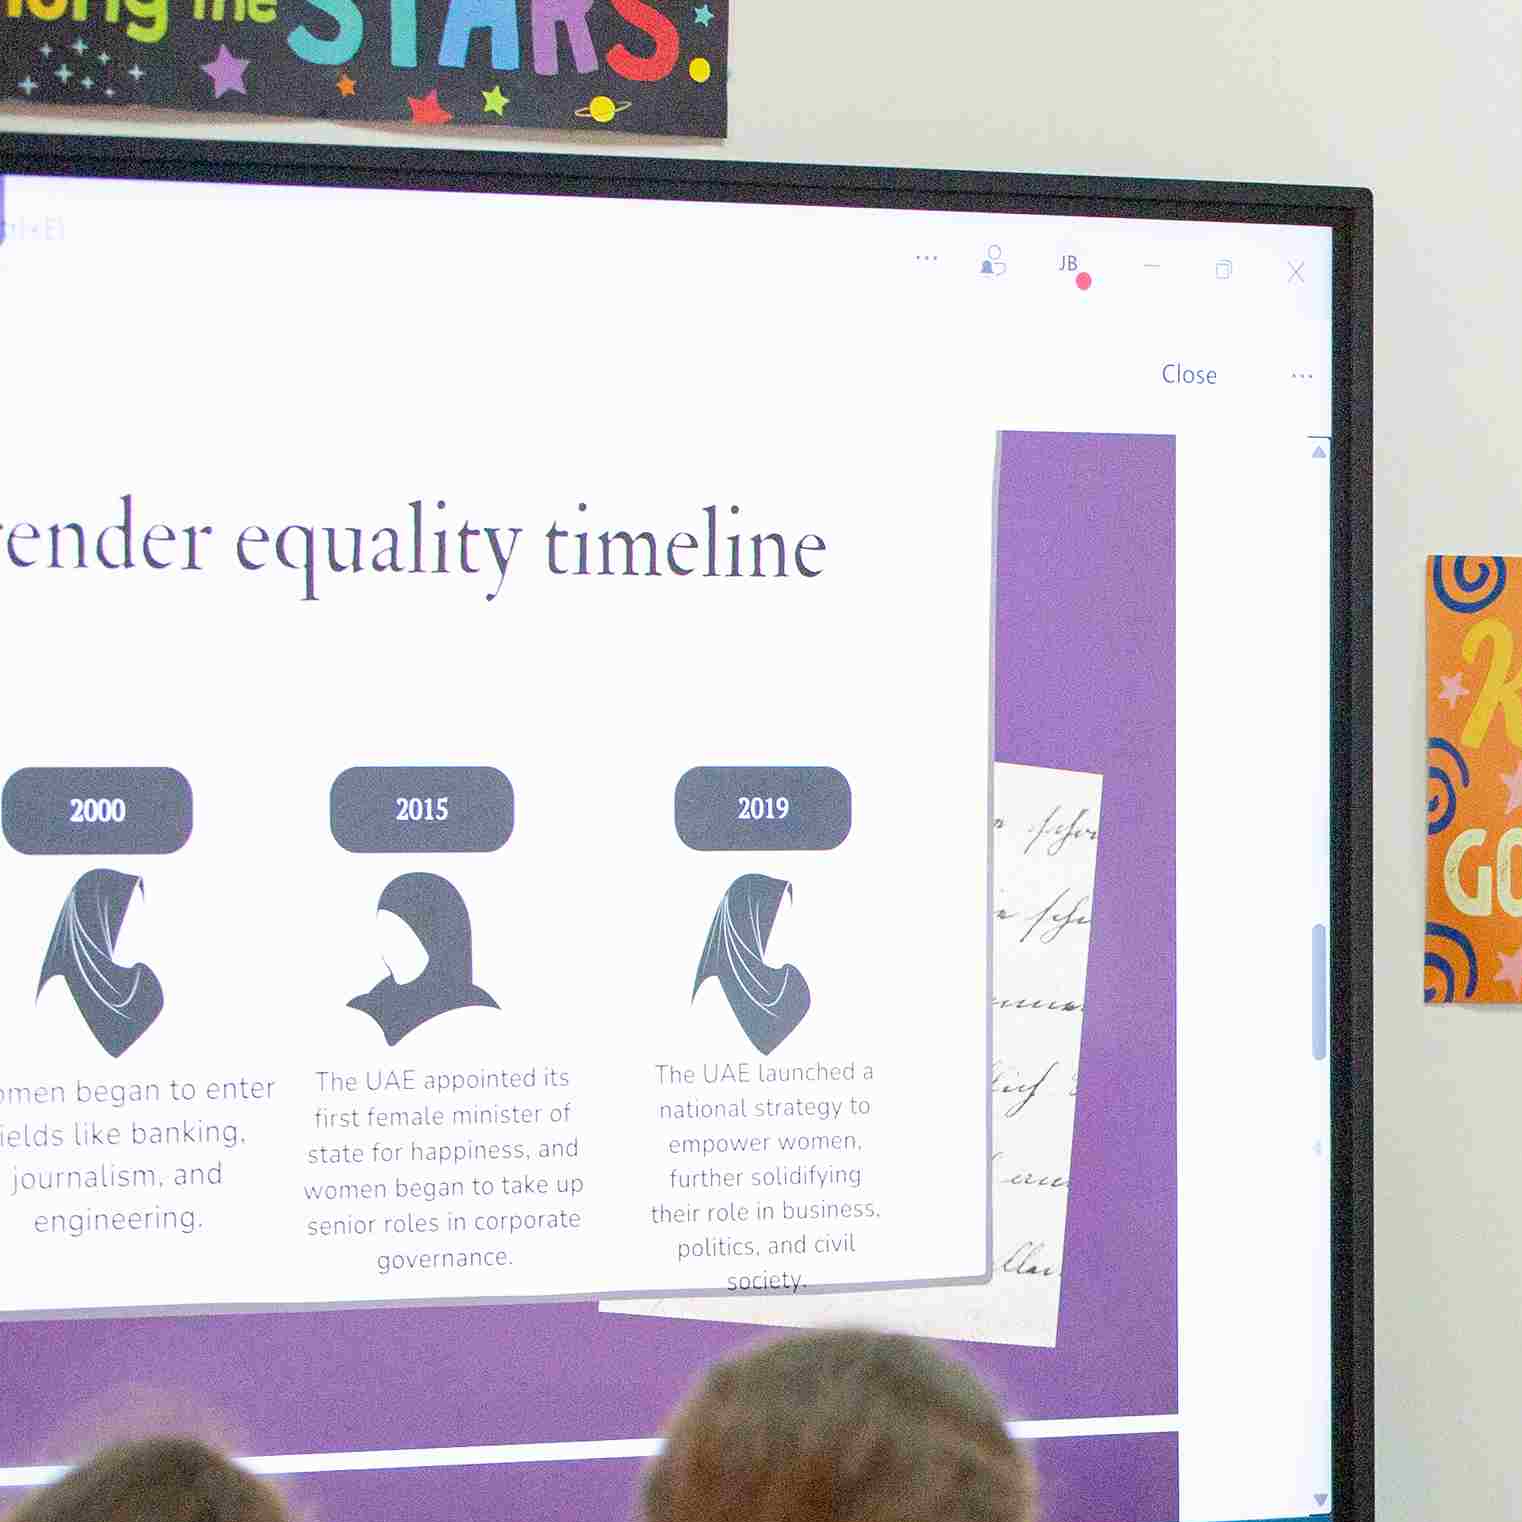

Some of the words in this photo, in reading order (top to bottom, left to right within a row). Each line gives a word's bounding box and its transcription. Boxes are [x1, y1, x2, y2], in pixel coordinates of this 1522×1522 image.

[1058, 255, 1078, 272] JB
[1162, 364, 1217, 386] Close
[0, 494, 212, 570] ender
[237, 500, 523, 601] equality
[546, 502, 827, 578] timeline
[71, 799, 125, 822] 2000
[397, 798, 448, 820] 2015
[739, 797, 788, 819] 2019
[314, 1070, 358, 1092] The
[365, 1068, 416, 1092] UAE
[423, 1067, 536, 1094] appointed
[544, 1066, 570, 1088] its
[654, 1063, 695, 1085] The
[703, 1062, 750, 1085] UAE
[758, 1061, 855, 1083] launched
[862, 1065, 874, 1081] a
[0, 1085, 65, 1104] men
[76, 1079, 160, 1109] began
[169, 1079, 196, 1102] to
[205, 1077, 276, 1100] enter
[314, 1107, 360, 1129] first
[367, 1105, 445, 1128] female
[452, 1104, 543, 1125] minister
[549, 1101, 571, 1123] of
[659, 1097, 748, 1120] national
[754, 1098, 843, 1121] strategy
[849, 1096, 871, 1115] to
[74, 1121, 121, 1147] like
[308, 1144, 364, 1165] state
[371, 1141, 404, 1163] for
[411, 1139, 531, 1165] happiness,
[538, 1136, 579, 1159] and
[668, 1137, 771, 1157] empower
[173, 1160, 223, 1187] and
[669, 1167, 744, 1189] further
[751, 1164, 861, 1189] solidifying
[303, 1183, 387, 1201] women
[395, 1177, 464, 1202] began
[471, 1177, 495, 1196] to
[501, 1174, 549, 1196] take
[556, 1177, 584, 1198] up
[33, 1204, 203, 1238] engineering.
[307, 1214, 377, 1237] senior
[384, 1212, 440, 1234] roles
[447, 1211, 467, 1231] in
[474, 1210, 582, 1235] corporate
[650, 1203, 701, 1225] their
[707, 1201, 750, 1223] role
[756, 1201, 775, 1221] in
[767, 1233, 807, 1256] and
[813, 1232, 856, 1254] civil
[376, 1250, 513, 1276] governance.
[726, 1270, 808, 1295] society.
